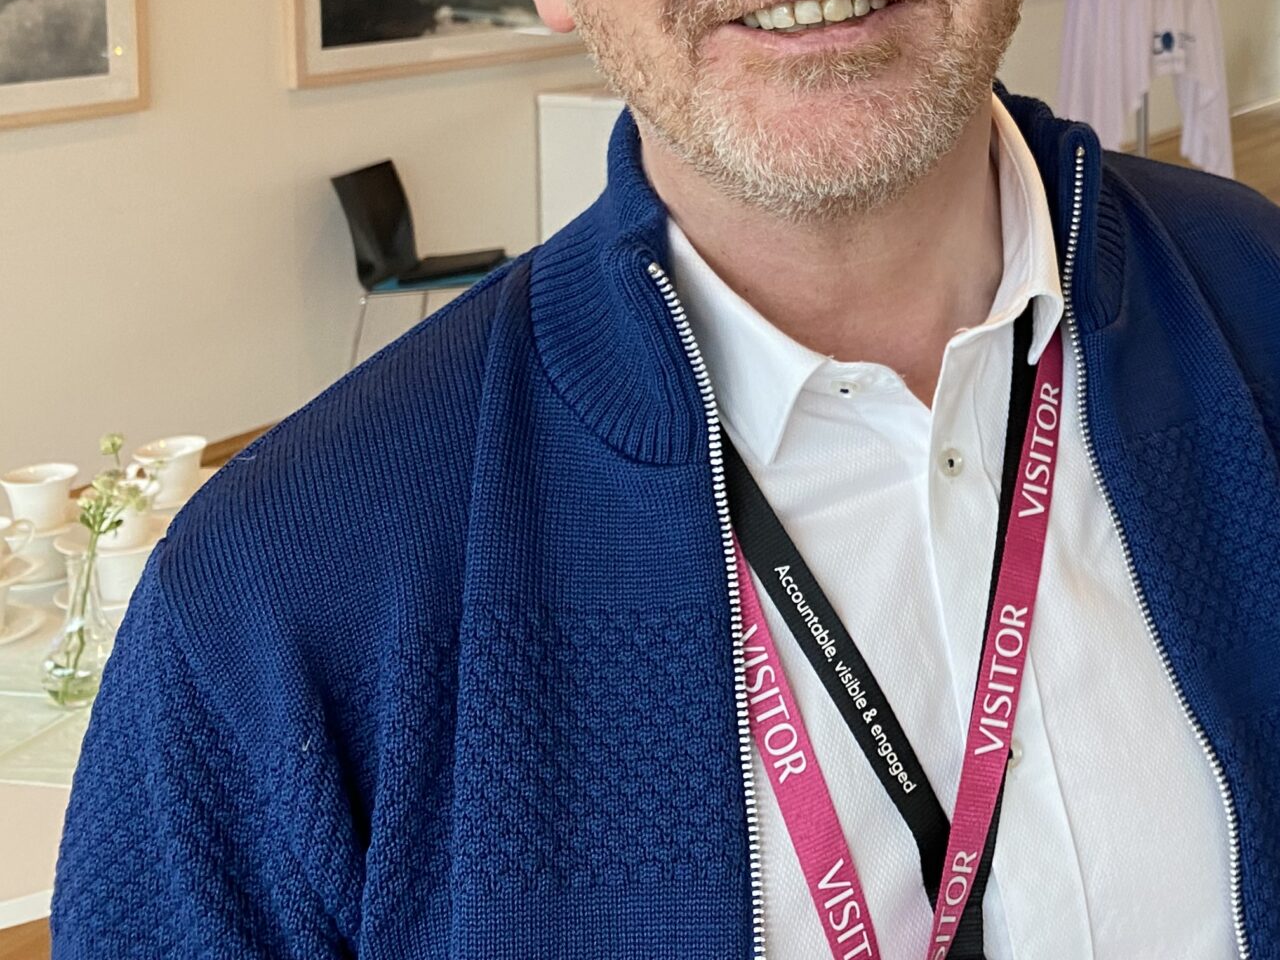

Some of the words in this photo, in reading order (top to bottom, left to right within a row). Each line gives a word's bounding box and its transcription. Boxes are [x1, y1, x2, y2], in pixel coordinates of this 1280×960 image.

[1018, 381, 1060, 518] VISITOR
[740, 623, 807, 784] VISITOR
[774, 565, 837, 662] Accountable,
[835, 660, 867, 709] visible
[862, 708, 878, 724] &
[871, 724, 917, 794] engaged
[974, 604, 1028, 756] VISITOR
[817, 858, 872, 960] VISIT
